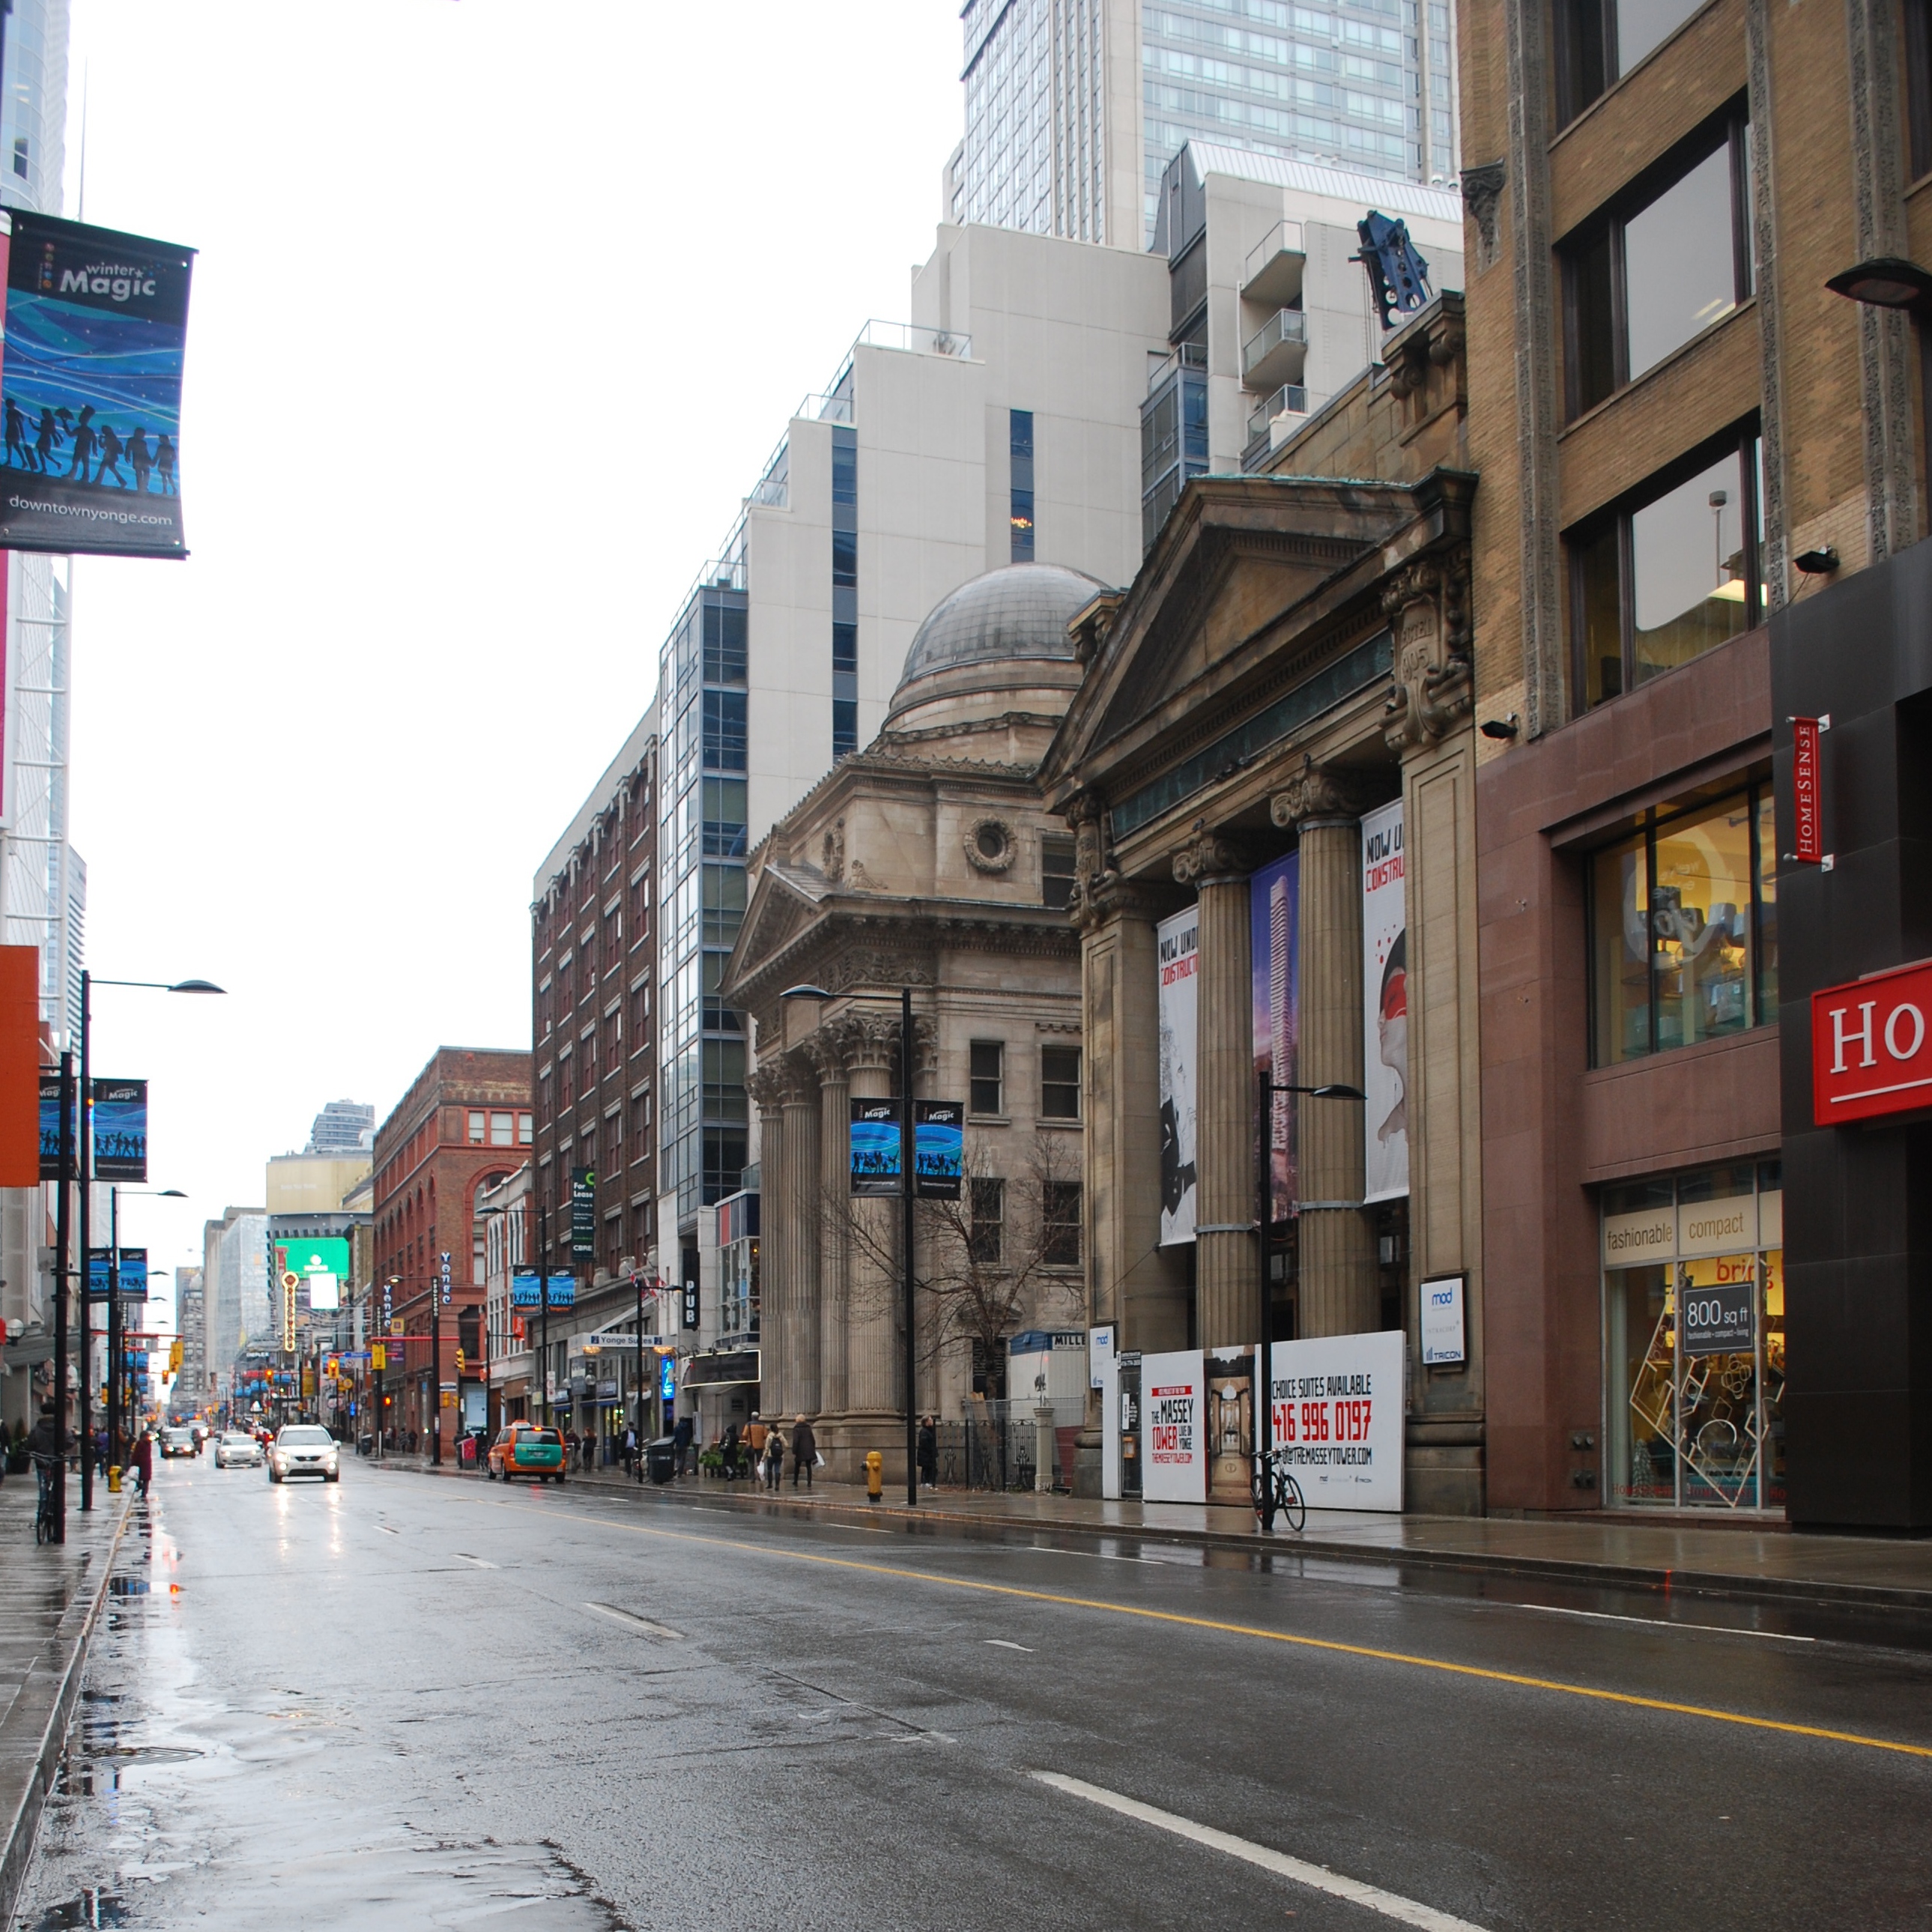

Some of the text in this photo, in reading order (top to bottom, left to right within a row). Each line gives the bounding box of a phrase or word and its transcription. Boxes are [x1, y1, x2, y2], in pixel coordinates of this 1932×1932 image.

[85, 261, 136, 276] winter
[59, 270, 156, 302] Magic
[9, 495, 172, 525] downtownyonge.com
[1367, 823, 1405, 864] NOW U
[1161, 935, 1178, 964] NOW
[109, 1090, 139, 1100] Magic
[864, 1109, 891, 1119] Magic
[928, 1112, 954, 1121] Magic
[1607, 1212, 1744, 1250] fashionable compact
[686, 1280, 695, 1322] PUB
[1432, 1287, 1453, 1306] mod
[1687, 1300, 1748, 1327] 800 sq ft
[601, 1336, 626, 1345] Yonge
[1434, 1351, 1462, 1361] TRICON
[1273, 1374, 1372, 1399] CHOICE SUITES AVAILABLE
[1151, 1411, 1160, 1424] THE
[1160, 1399, 1193, 1424] MASSEY
[1273, 1400, 1372, 1441] 416 996 0197
[1152, 1426, 1178, 1450] TOWER
